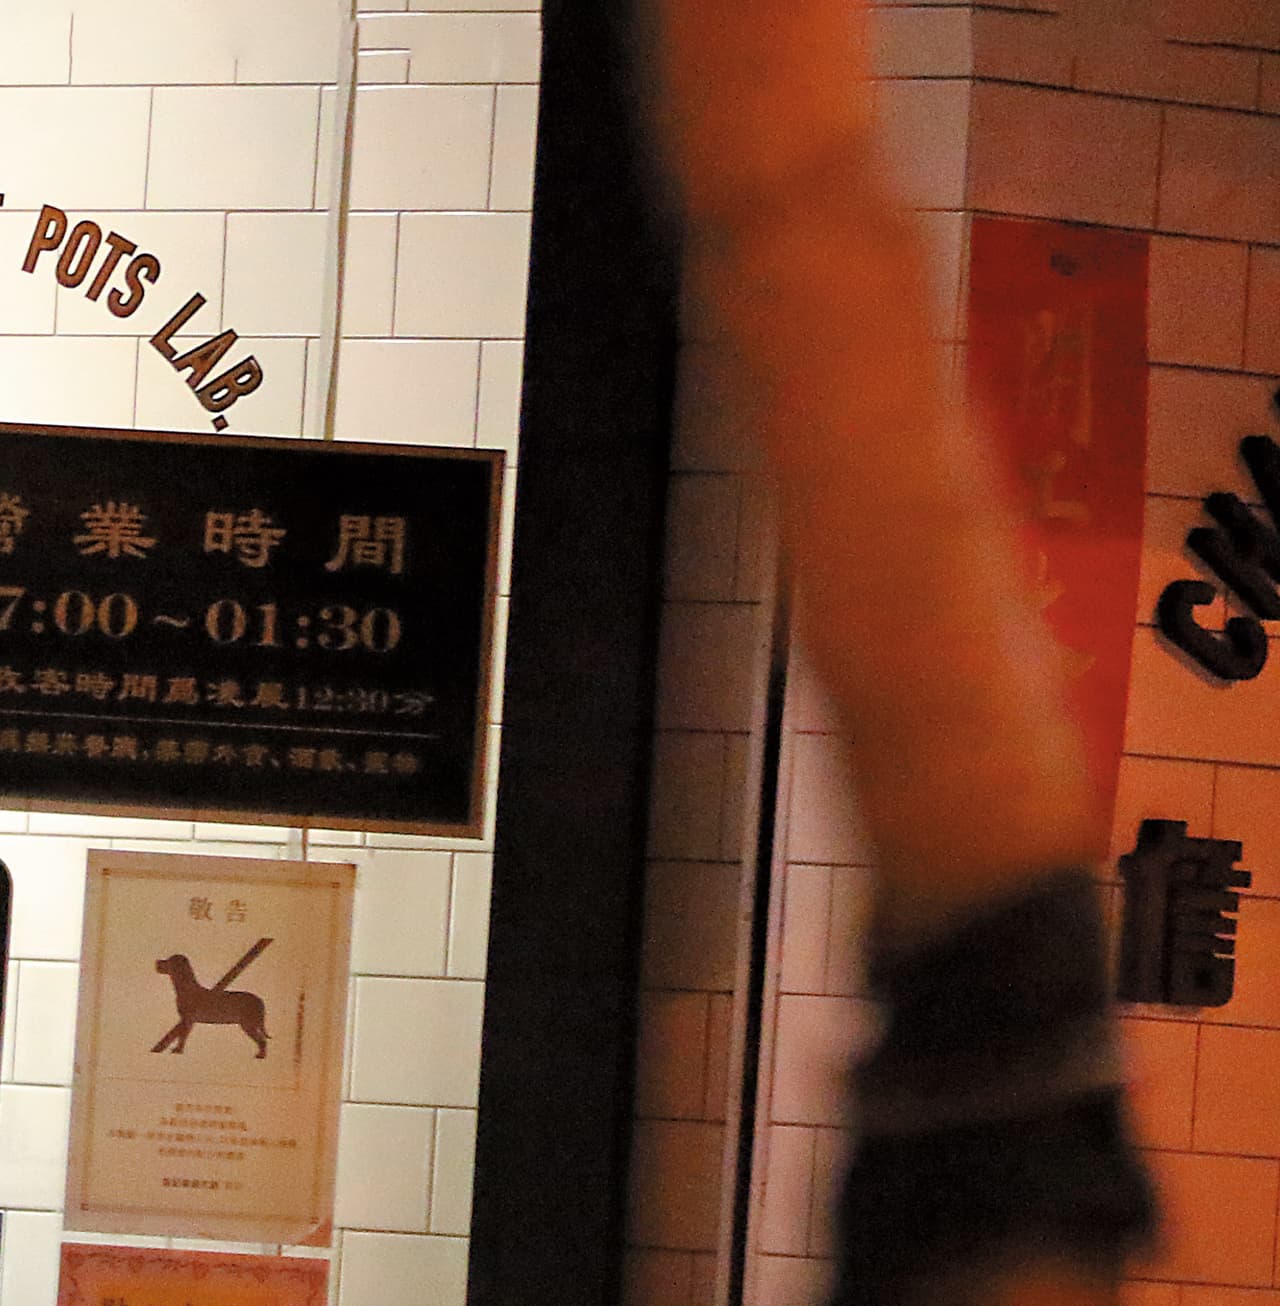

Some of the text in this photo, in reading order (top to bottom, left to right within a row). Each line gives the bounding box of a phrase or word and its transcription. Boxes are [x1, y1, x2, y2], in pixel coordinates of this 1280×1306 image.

[21, 204, 161, 318] POTS
[149, 292, 263, 432] LAB.
[189, 897, 248, 924] 敬告
